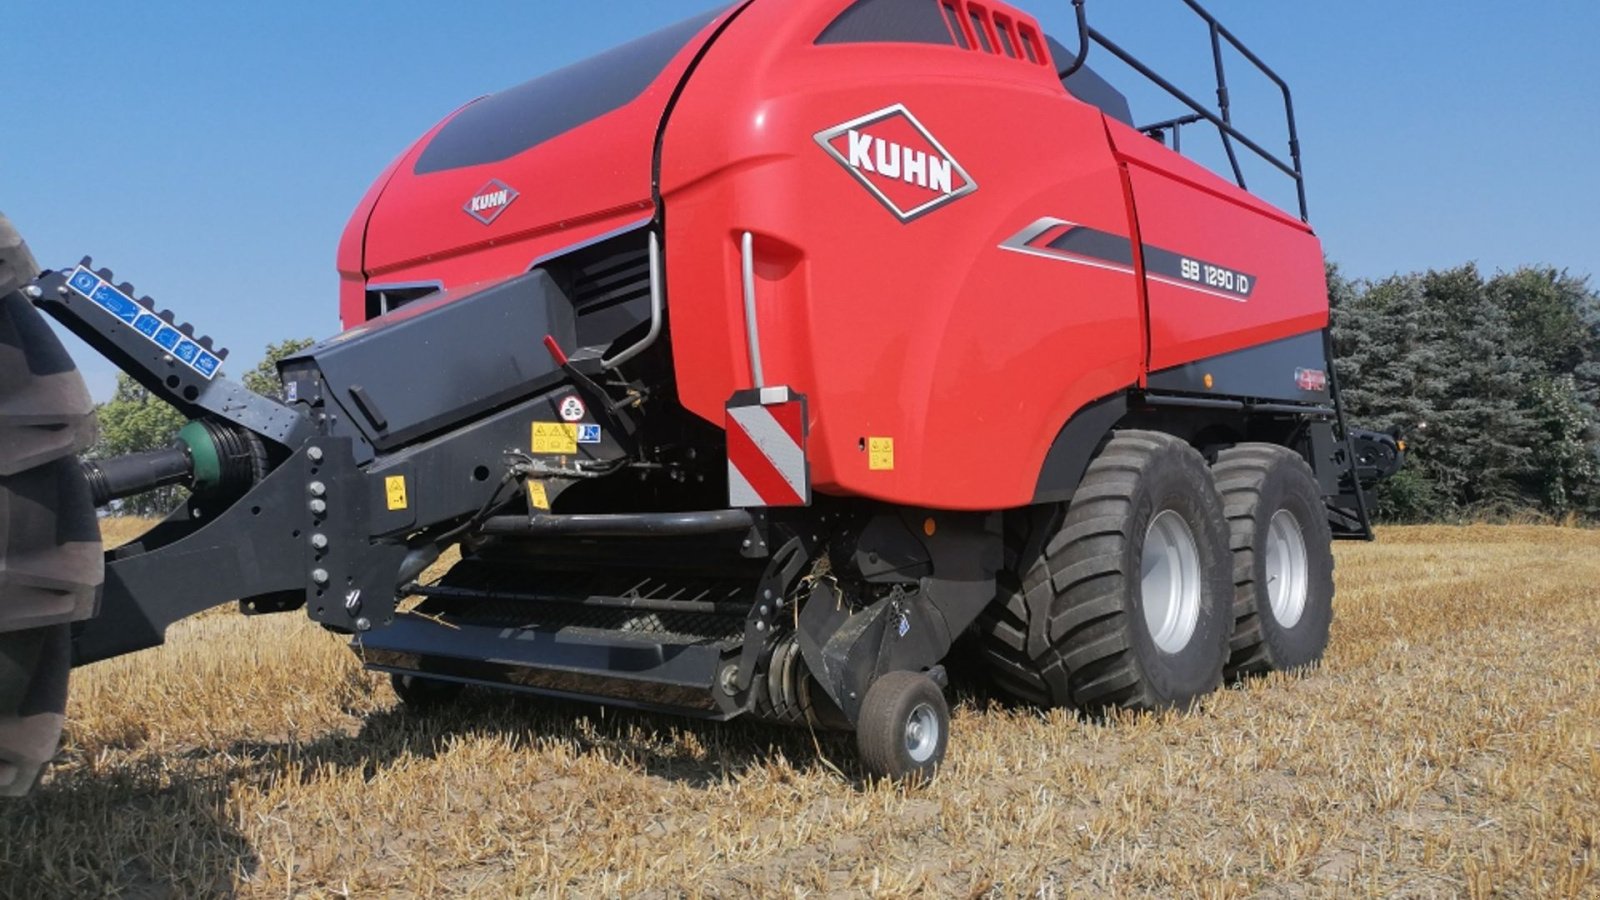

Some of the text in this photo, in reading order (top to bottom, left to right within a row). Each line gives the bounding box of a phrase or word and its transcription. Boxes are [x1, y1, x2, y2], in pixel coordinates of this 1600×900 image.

[848, 129, 952, 195] KUHN
[471, 189, 508, 211] KUHN
[1181, 258, 1200, 281] SB
[1204, 265, 1233, 290] 1290
